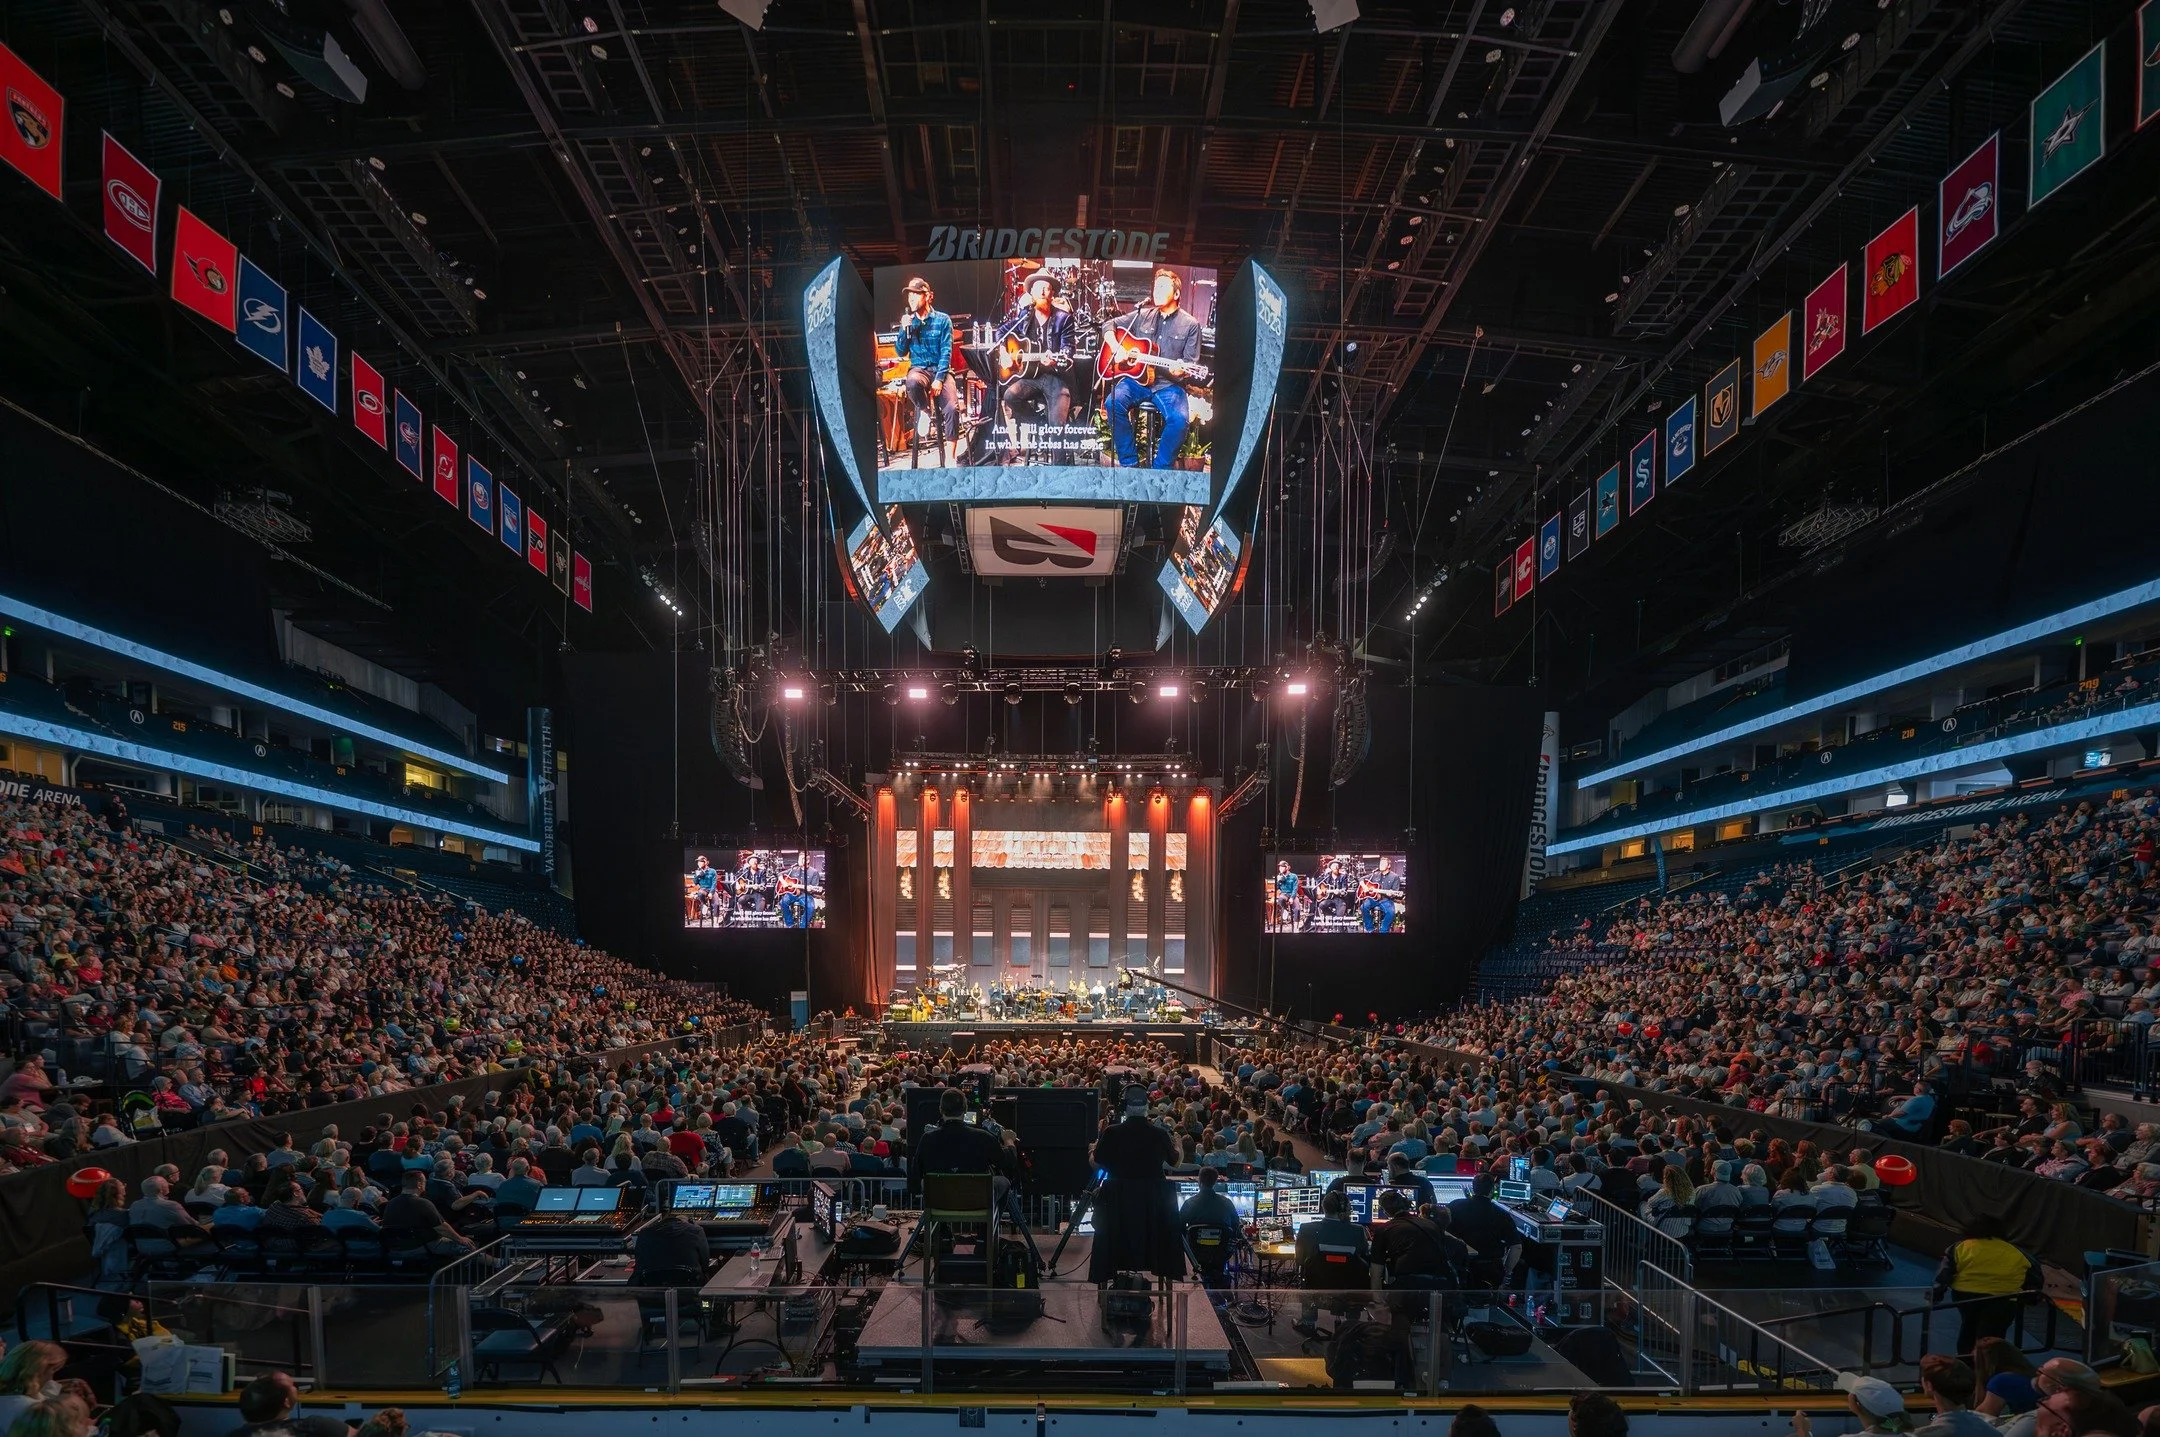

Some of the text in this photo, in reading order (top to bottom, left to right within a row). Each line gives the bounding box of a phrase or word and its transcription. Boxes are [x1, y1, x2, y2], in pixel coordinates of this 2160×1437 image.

[925, 225, 1169, 261] BRIDGESTONE
[808, 298, 832, 334] 2023
[1038, 423, 1062, 436] glory
[1064, 423, 1097, 435] forever
[985, 439, 996, 450] In
[1063, 439, 1079, 450] has
[2078, 677, 2100, 692] 209
[172, 719, 188, 733] 215
[541, 726, 553, 774] HEALTH
[33, 788, 81, 807] ARENA
[1868, 787, 2068, 831] BRIDGESTONE ARENA
[543, 798, 556, 875] VANDERBILT
